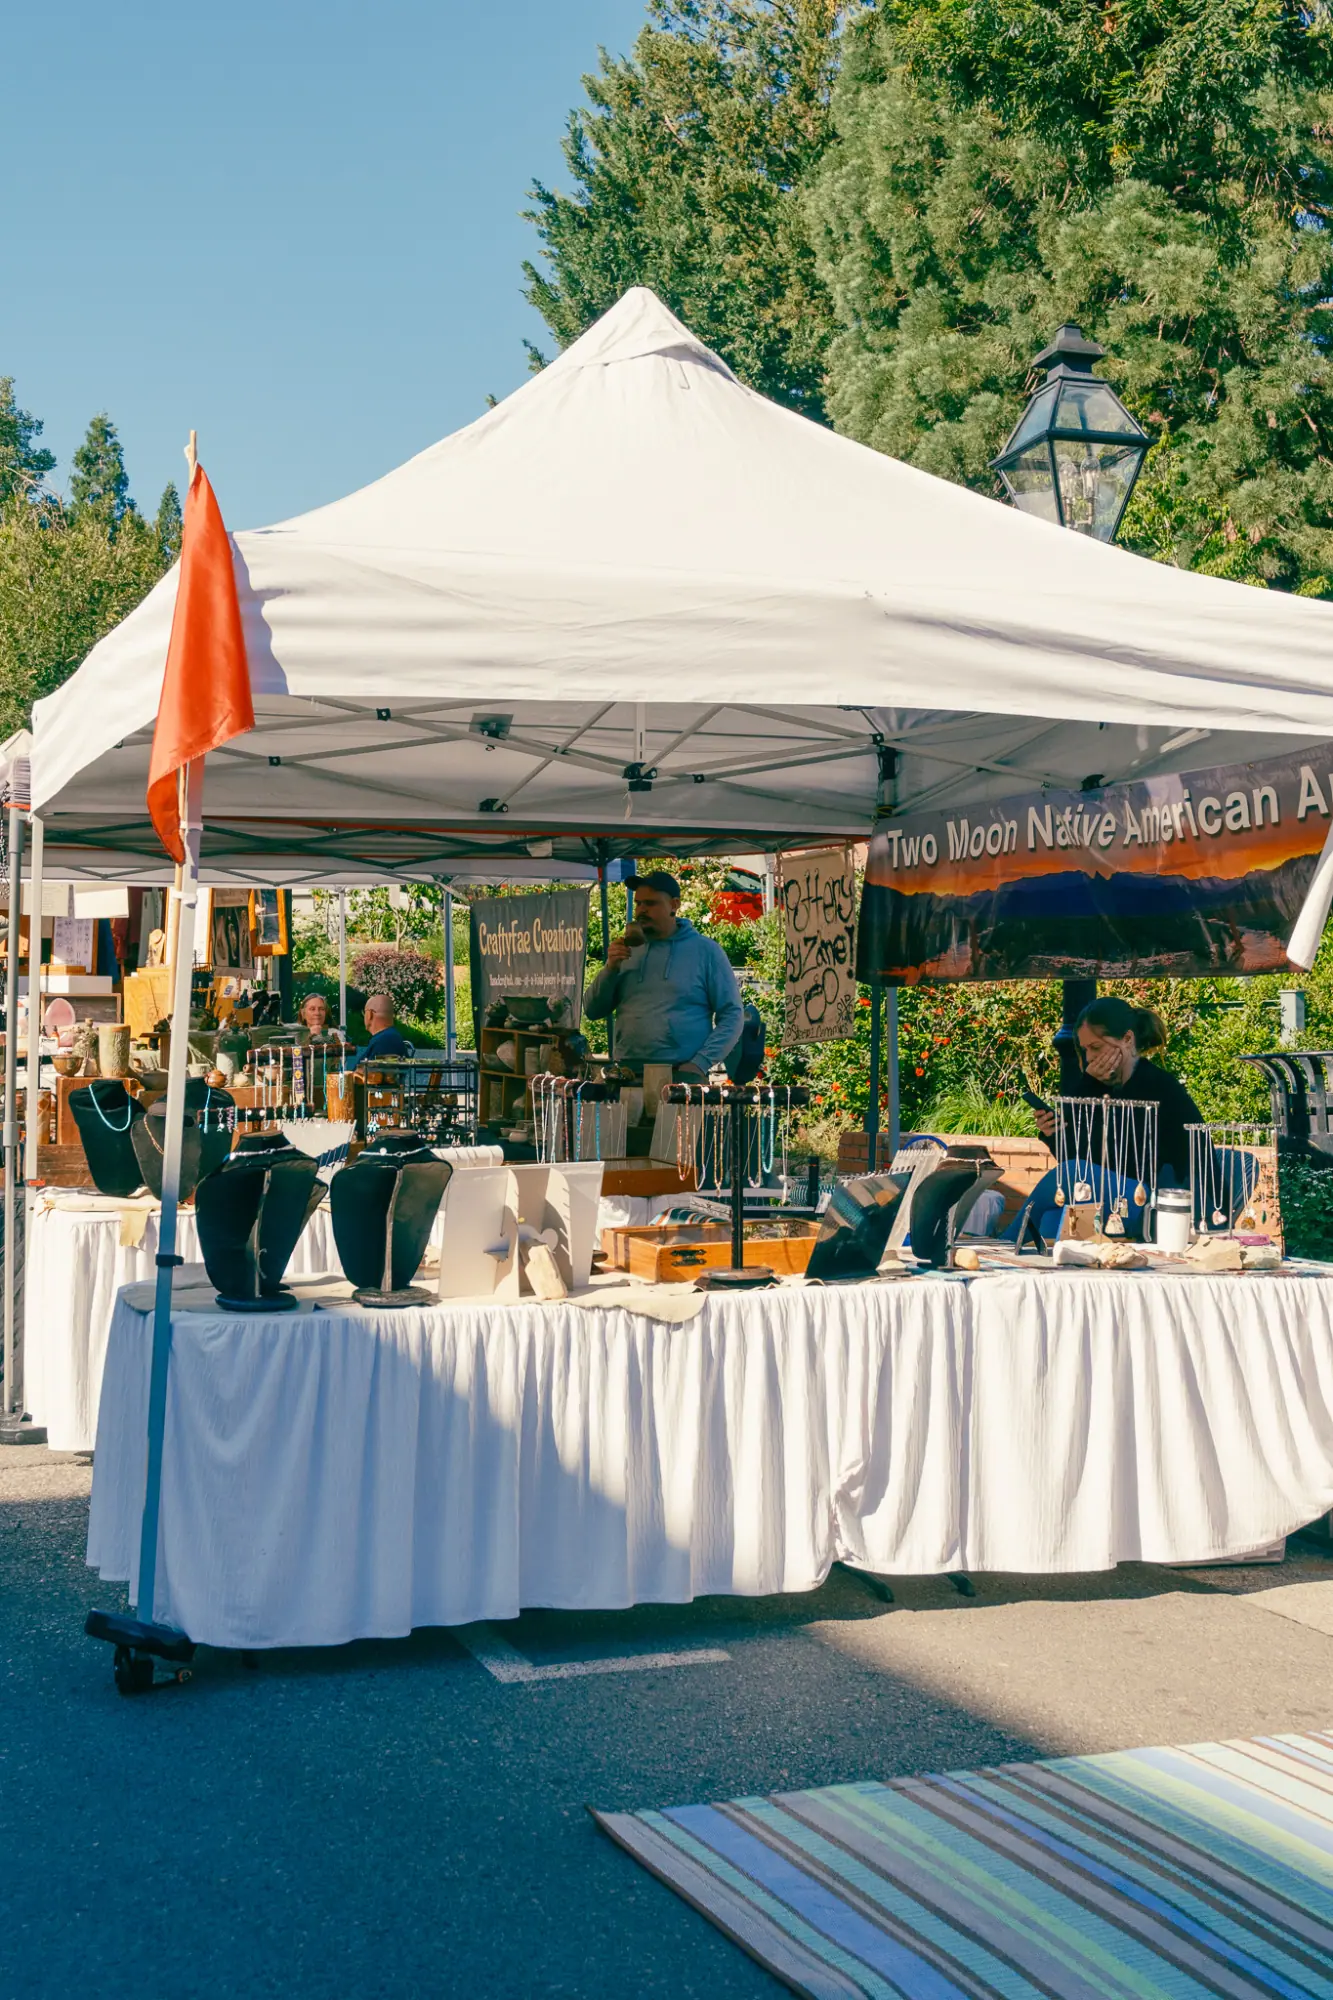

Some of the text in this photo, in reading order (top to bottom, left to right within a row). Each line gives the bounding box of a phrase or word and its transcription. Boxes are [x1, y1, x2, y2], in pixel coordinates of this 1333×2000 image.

[887, 765, 1333, 869] Two Moon Native American A
[784, 868, 854, 933] Pottery
[479, 917, 584, 967] CraftyFae Creations
[801, 926, 855, 980] Zane!
